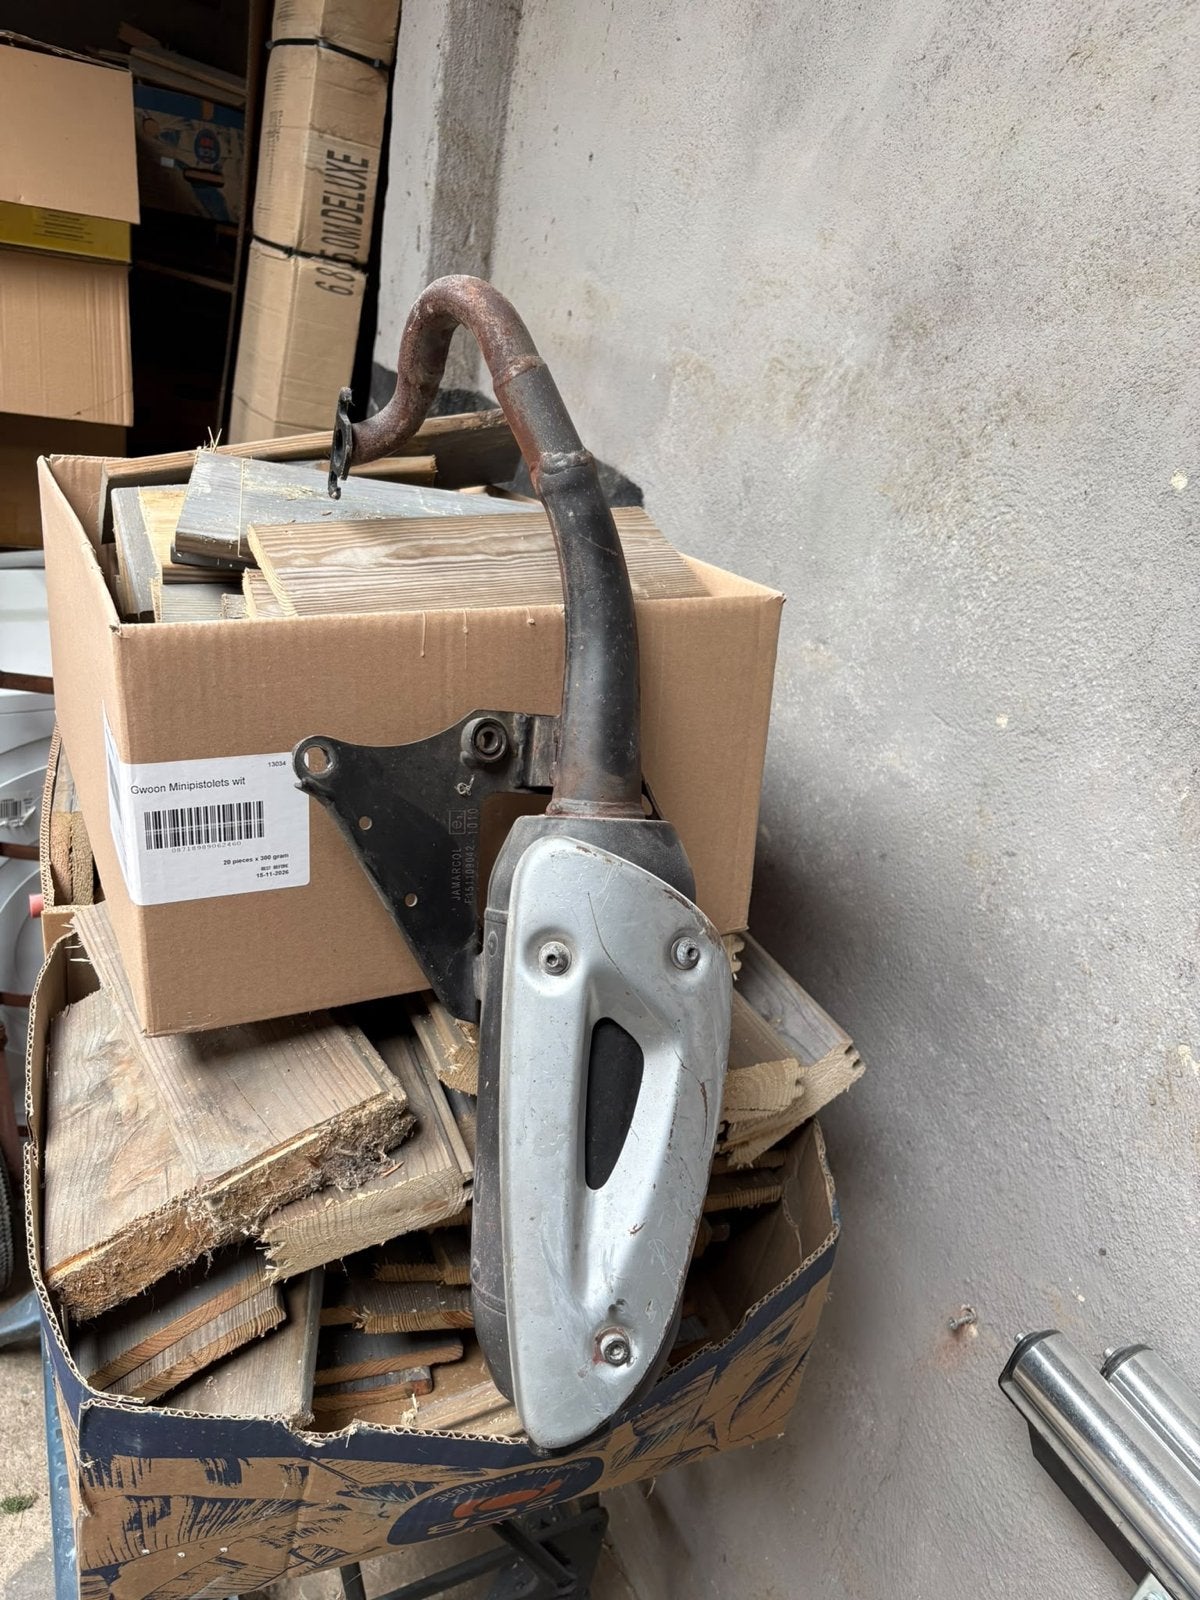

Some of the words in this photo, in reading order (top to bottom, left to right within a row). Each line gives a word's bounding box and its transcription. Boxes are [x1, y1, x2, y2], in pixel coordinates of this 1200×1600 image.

[320, 149, 370, 226] DELUXE
[268, 760, 286, 768] 13034
[130, 785, 166, 795] Gwoon
[169, 778, 230, 792] Minipistolets
[232, 776, 246, 786] wit
[232, 857, 253, 865] pieces
[273, 853, 289, 861] gram
[451, 848, 462, 901] JAMARCOL
